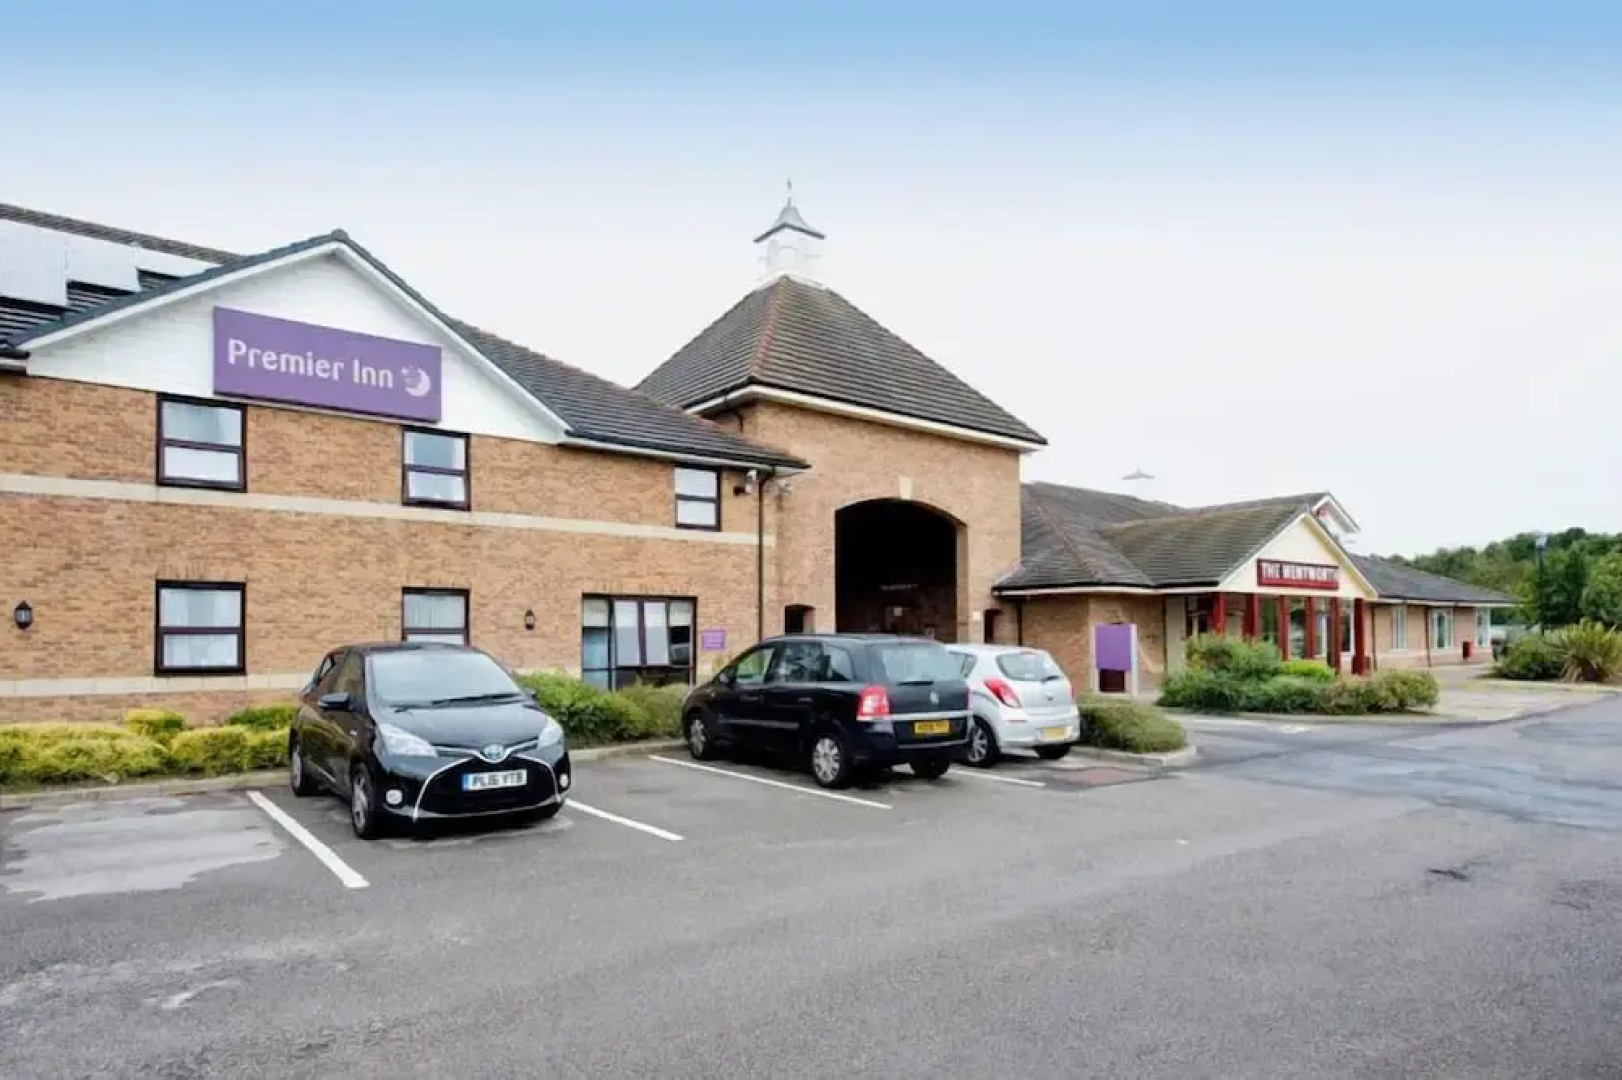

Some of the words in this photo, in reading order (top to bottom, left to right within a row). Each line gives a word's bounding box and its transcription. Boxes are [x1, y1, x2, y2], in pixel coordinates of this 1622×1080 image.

[227, 338, 344, 381] Premier
[352, 358, 394, 389] Inn
[1261, 562, 1280, 579] THE
